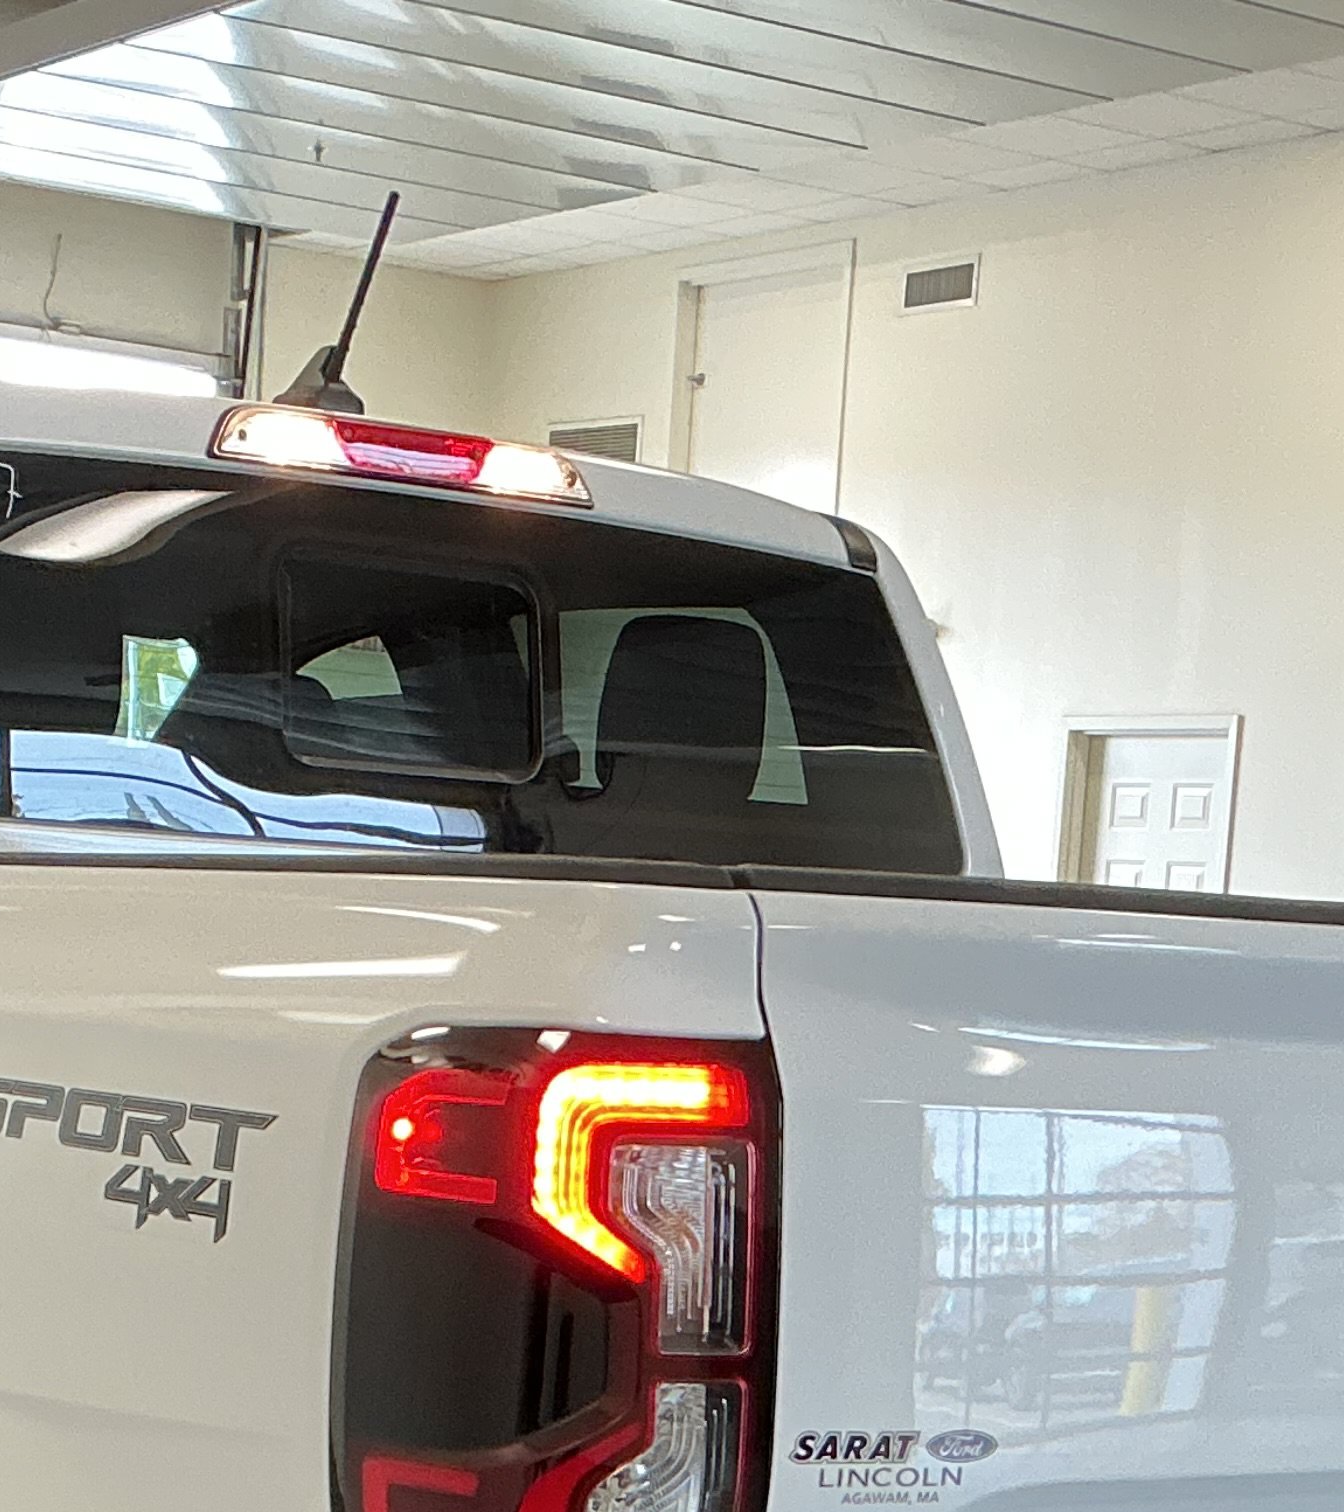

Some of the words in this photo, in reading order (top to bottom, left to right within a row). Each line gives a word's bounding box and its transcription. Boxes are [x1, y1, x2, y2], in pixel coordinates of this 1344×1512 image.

[789, 1430, 920, 1464] SARAT
[818, 1466, 963, 1488] LINCOLN
[841, 1492, 912, 1505] AGAWAM,
[916, 1491, 939, 1503] MA
